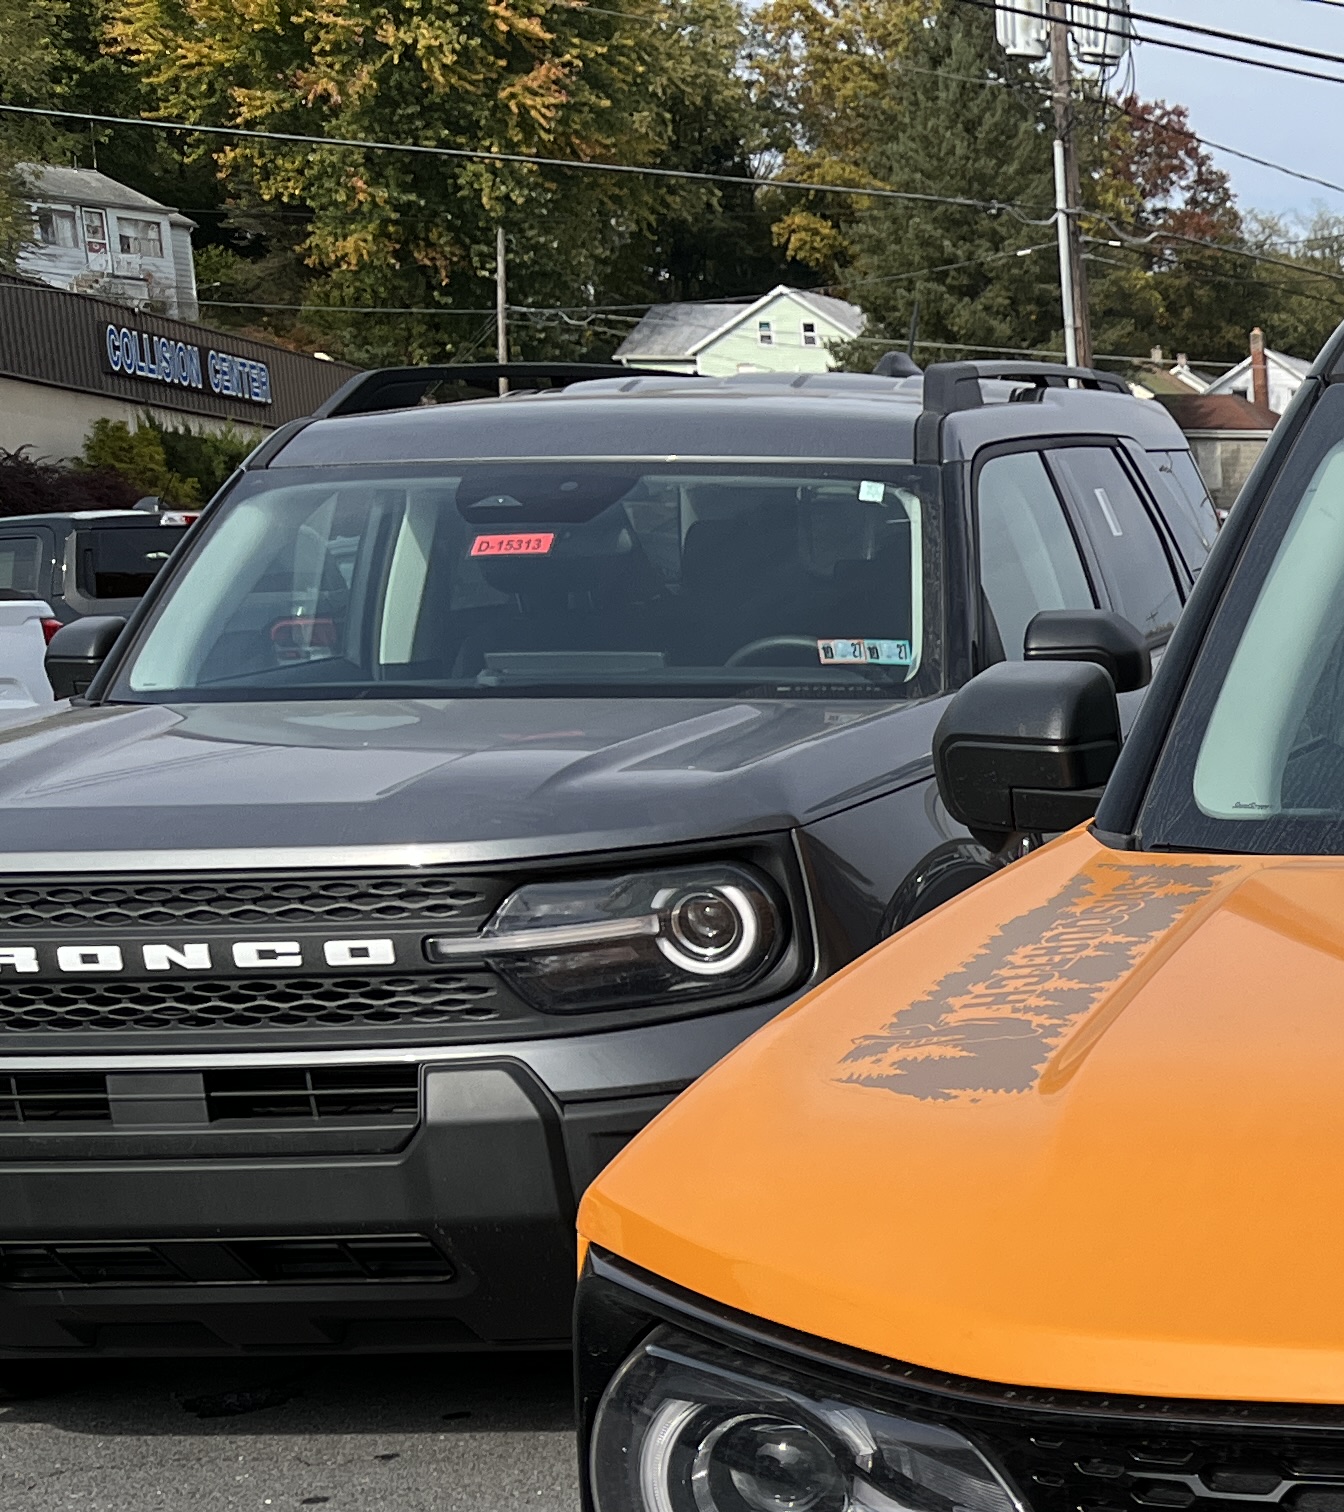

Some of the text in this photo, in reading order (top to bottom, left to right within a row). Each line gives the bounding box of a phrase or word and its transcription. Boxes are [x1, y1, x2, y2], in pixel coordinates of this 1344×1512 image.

[106, 324, 272, 404] COLLISION CENTER
[478, 539, 542, 553] D-15313
